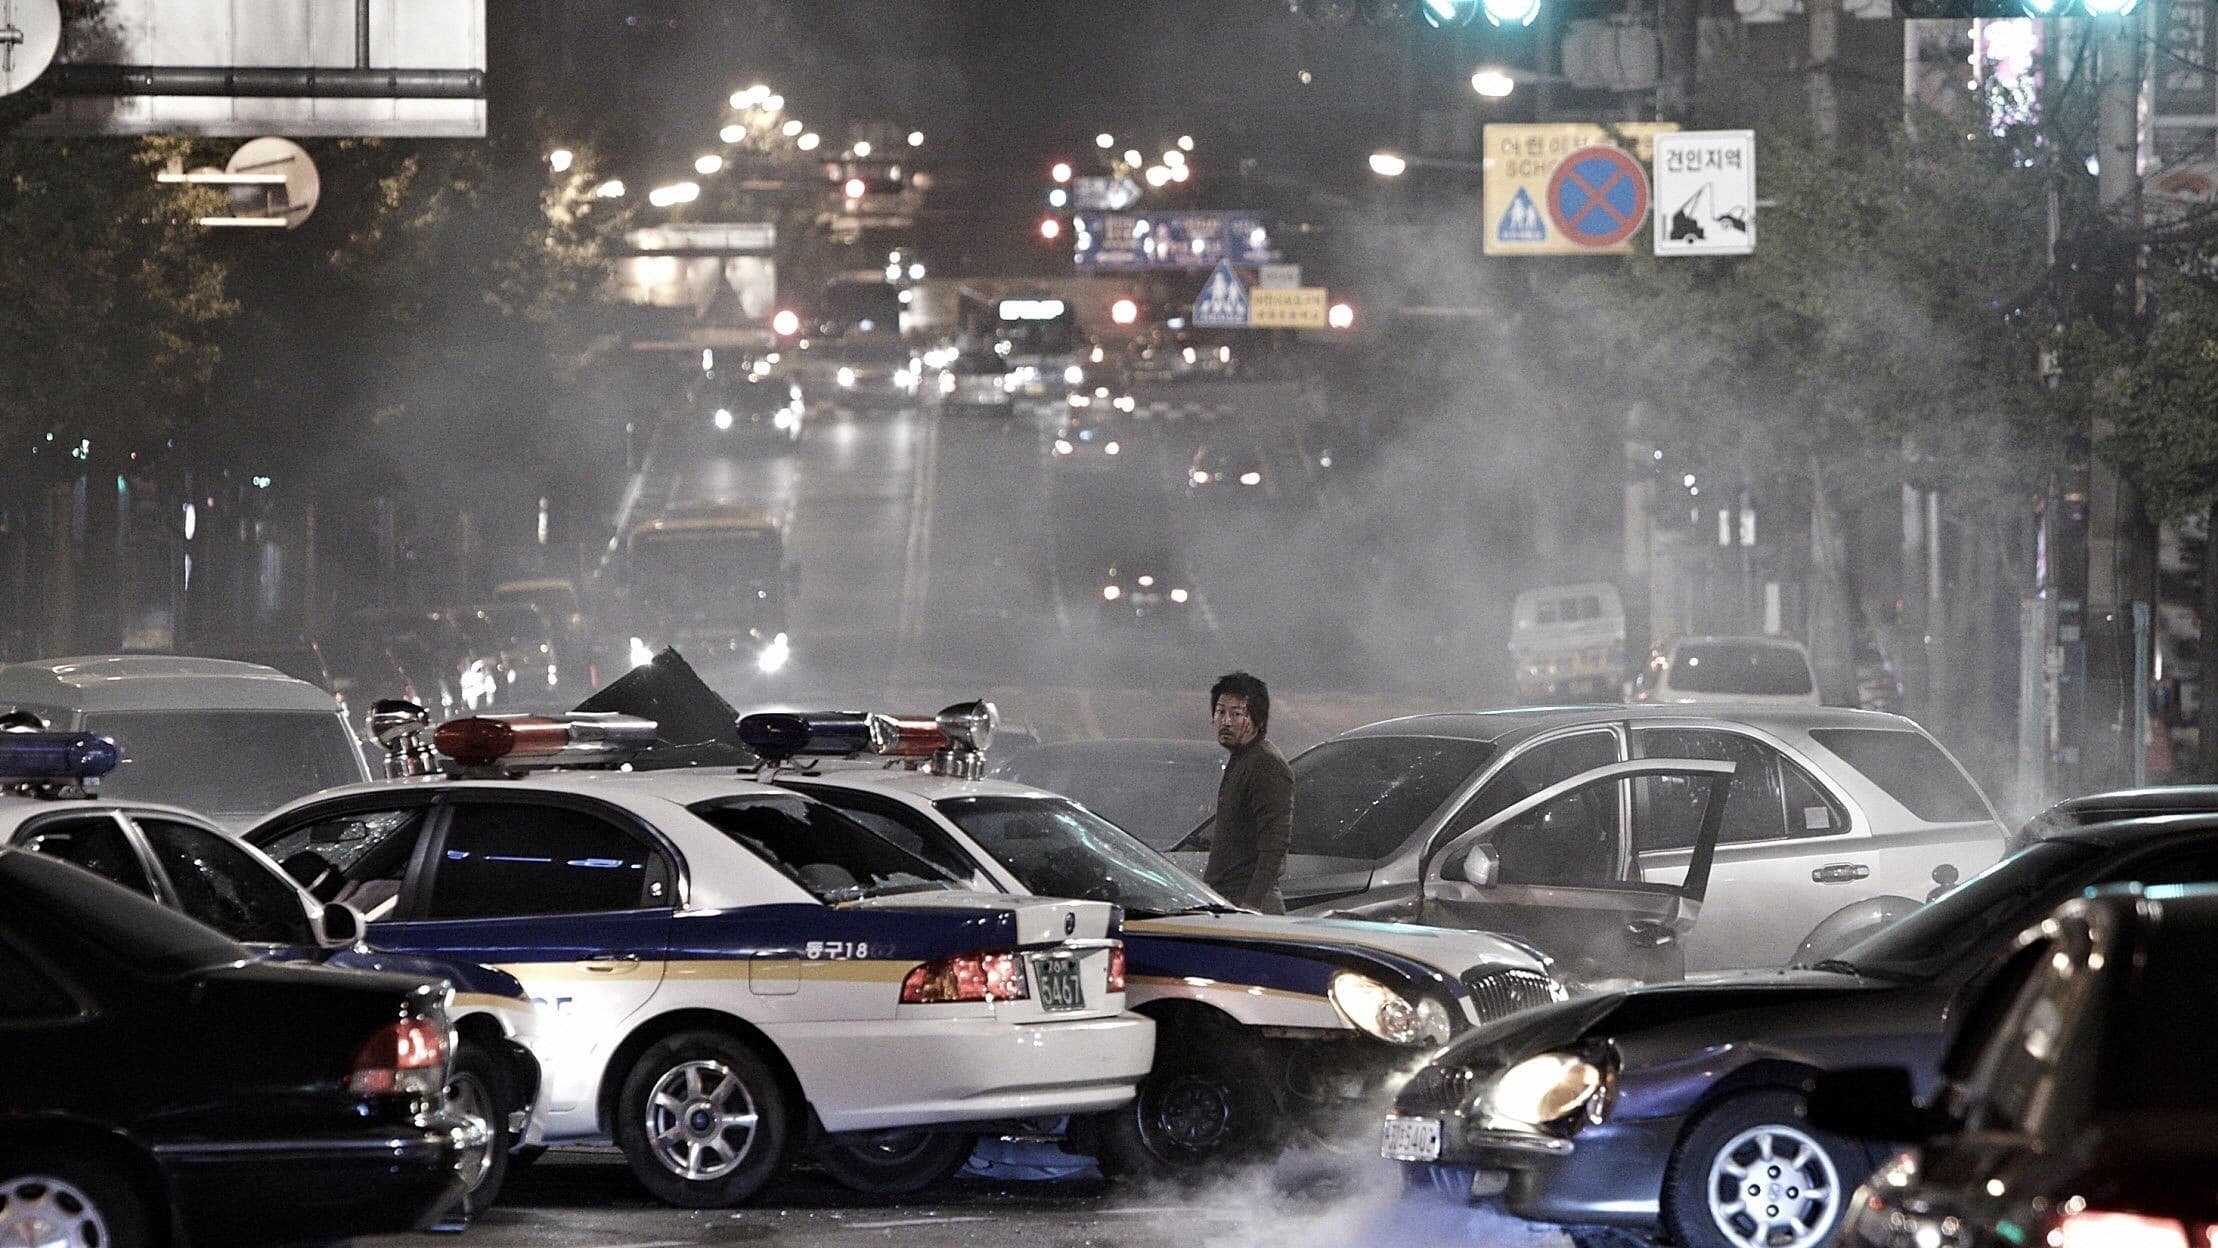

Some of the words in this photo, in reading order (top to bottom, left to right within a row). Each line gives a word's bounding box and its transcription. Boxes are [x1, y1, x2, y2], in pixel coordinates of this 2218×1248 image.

[1667, 148, 1742, 173] 견인지역
[806, 941, 868, 960] 동구18
[1041, 975, 1080, 1005] 5467
